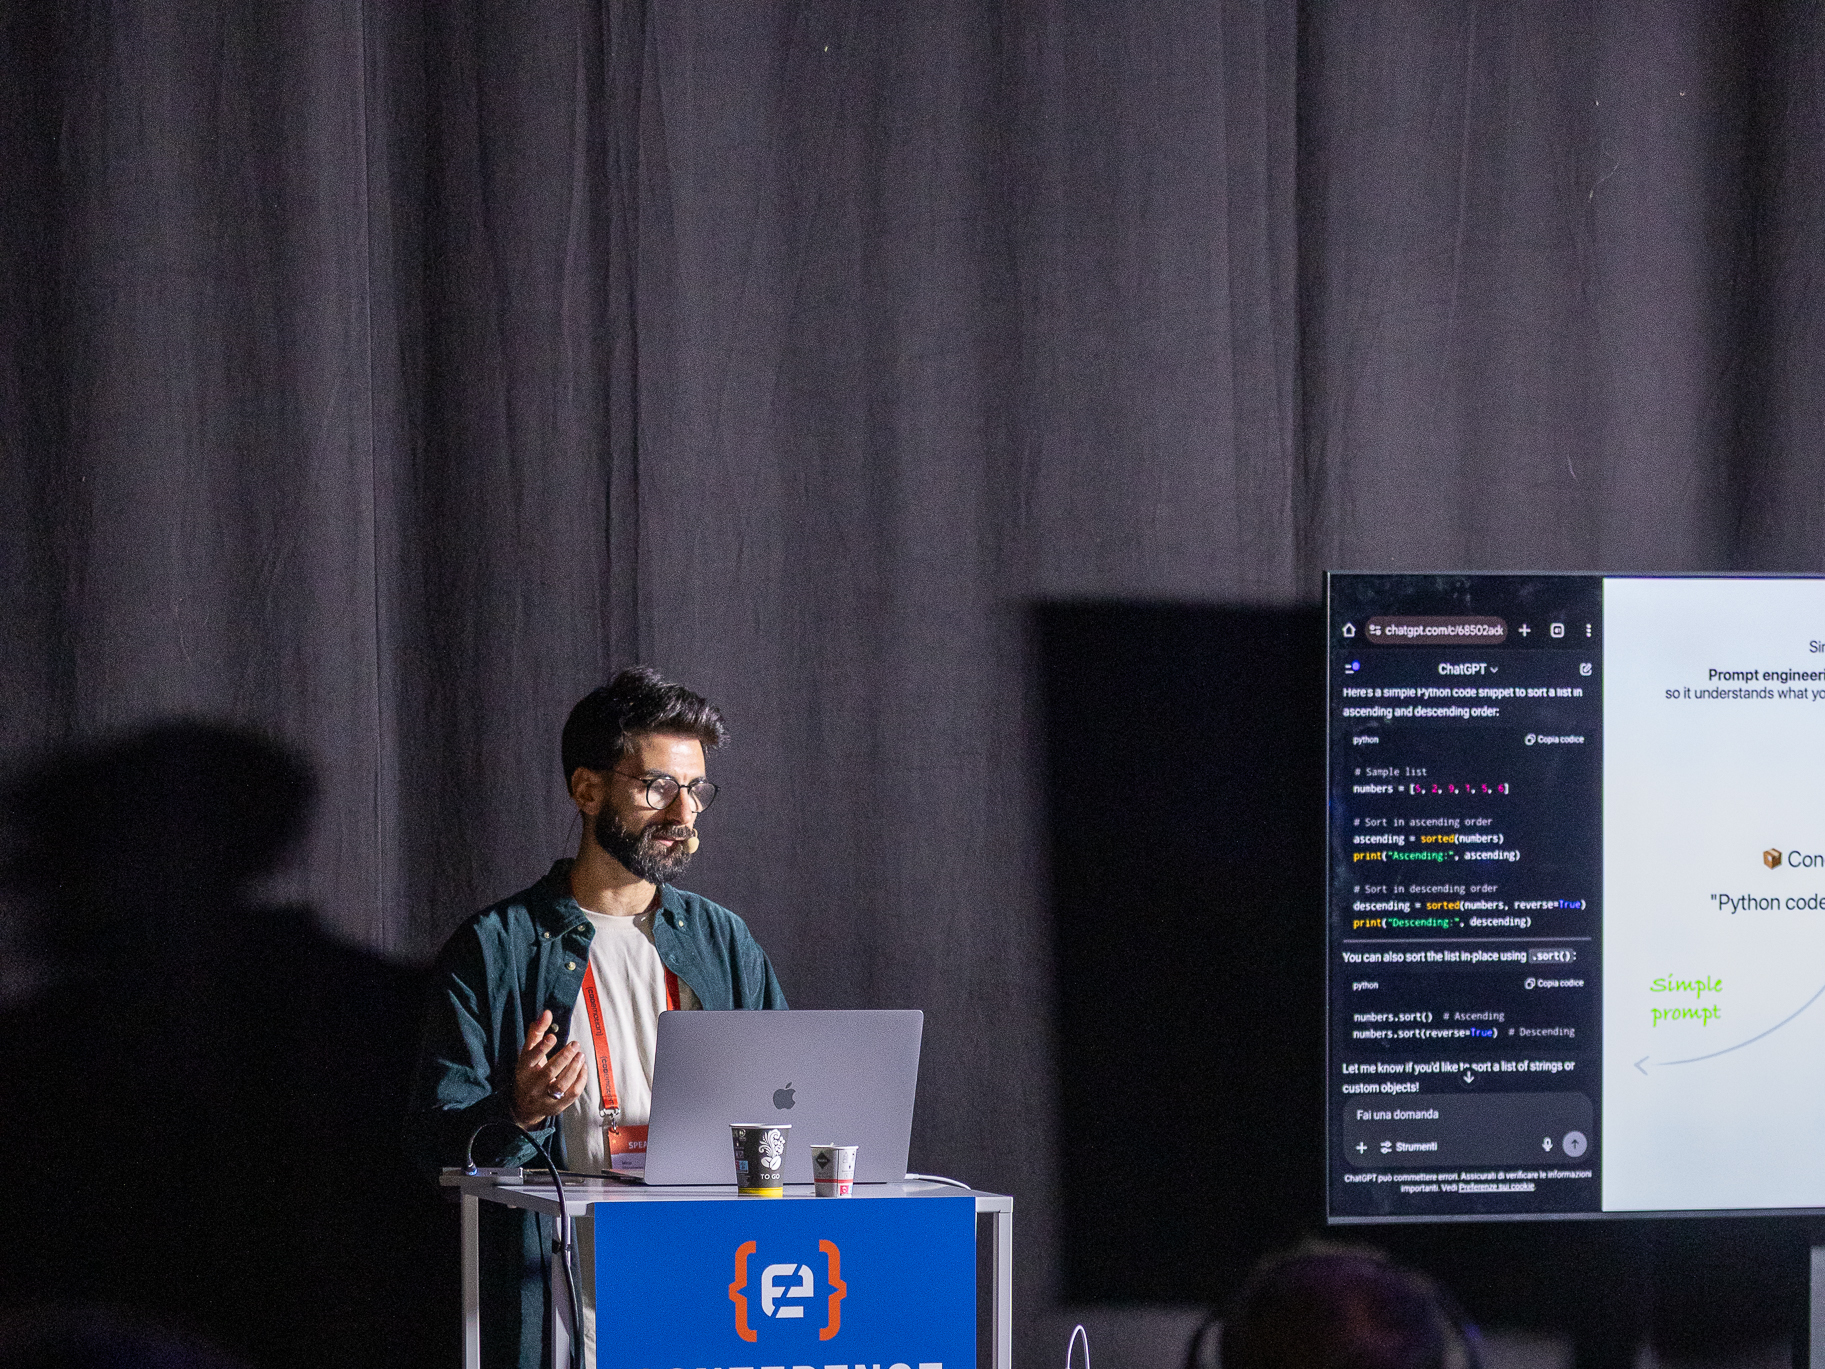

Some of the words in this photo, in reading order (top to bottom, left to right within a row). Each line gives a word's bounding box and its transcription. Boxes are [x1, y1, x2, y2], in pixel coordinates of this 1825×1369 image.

[1439, 663, 1487, 674] ChatGPT
[1708, 668, 1759, 684] Prompt
[1383, 688, 1416, 699] simple
[1417, 688, 1451, 699] Python
[1453, 688, 1476, 697] code
[1479, 688, 1513, 699] snippet
[1515, 688, 1526, 697] to
[1527, 688, 1547, 697] sort
[1548, 689, 1555, 697] a
[1557, 688, 1570, 697] list
[1571, 688, 1583, 697] in
[1665, 689, 1680, 699] so
[1684, 686, 1691, 699] it
[1694, 686, 1774, 699] understands
[1777, 686, 1808, 699] what
[1343, 706, 1392, 718] ascending
[1394, 706, 1413, 717] and
[1414, 706, 1469, 718] descending
[1471, 706, 1499, 716] order:
[1353, 736, 1379, 745] python
[1366, 768, 1399, 777] Sample
[1406, 768, 1427, 776] list
[1365, 818, 1386, 826] Sort
[1394, 818, 1404, 826] in
[1410, 818, 1460, 828] ascending
[1465, 818, 1492, 826] order
[1353, 835, 1404, 845] ascending
[1421, 834, 1504, 844] sorted(numbers)
[1464, 851, 1520, 861] ascending)
[1365, 885, 1386, 893] Sort
[1394, 885, 1404, 893] in
[1410, 884, 1465, 895] descending
[1470, 884, 1498, 893] order
[1353, 901, 1410, 912] descending
[1711, 894, 1780, 914] "Python
[1470, 917, 1531, 928] descending)
[1343, 952, 1362, 962] You
[1363, 953, 1382, 962] can
[1383, 952, 1404, 962] also
[1405, 952, 1425, 962] sort
[1427, 952, 1443, 961] the
[1444, 951, 1459, 961] list
[1500, 952, 1527, 962] using
[1353, 981, 1378, 990] python
[1650, 974, 1722, 998] Simple
[1455, 1012, 1504, 1022] Ascending
[1651, 1004, 1721, 1027] prompt
[1520, 1028, 1575, 1038] Descending
[1343, 1064, 1358, 1073] Let
[1377, 1063, 1403, 1073] know
[1405, 1063, 1412, 1073] if
[1441, 1062, 1458, 1072] like
[1472, 1063, 1491, 1072] sort
[1493, 1063, 1499, 1071] a
[1501, 1061, 1515, 1071] list
[1517, 1061, 1529, 1071] of
[1530, 1062, 1562, 1073] strings
[1564, 1062, 1575, 1071] or
[1343, 1083, 1379, 1093] custom
[1381, 1083, 1419, 1094] objects!
[1357, 1110, 1371, 1119] Fai
[1374, 1111, 1391, 1119] una
[1394, 1109, 1438, 1119] domanda
[1396, 1142, 1437, 1151] Strumenti
